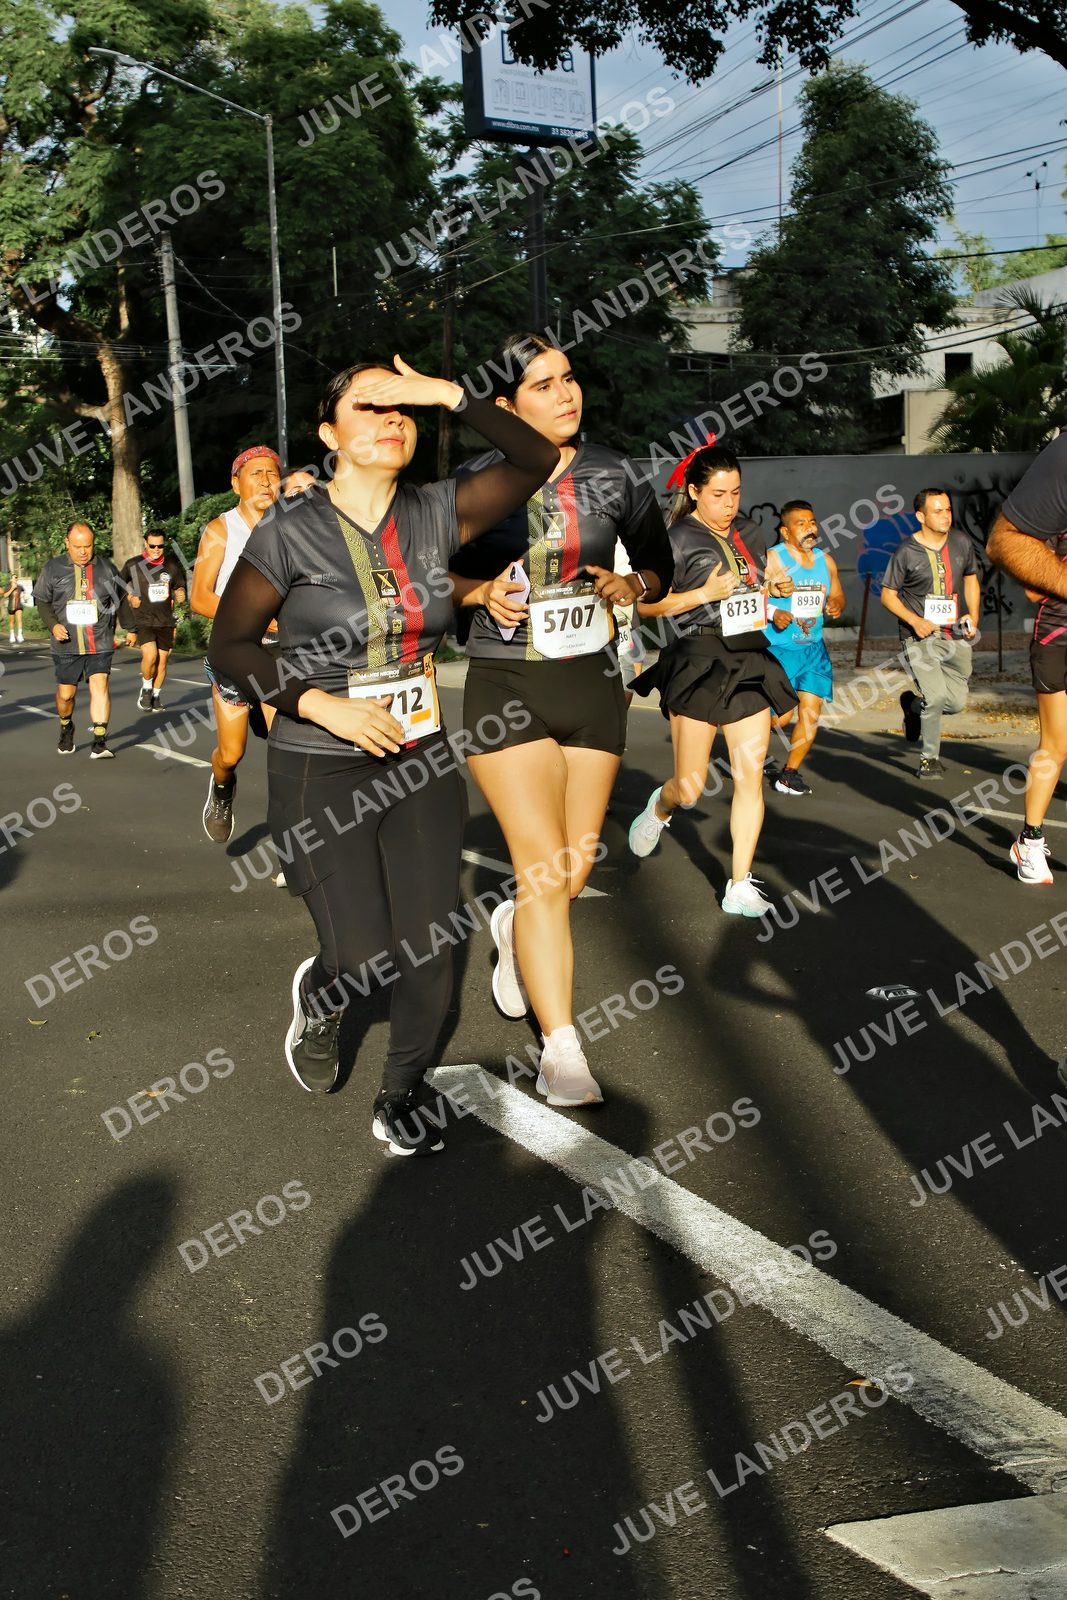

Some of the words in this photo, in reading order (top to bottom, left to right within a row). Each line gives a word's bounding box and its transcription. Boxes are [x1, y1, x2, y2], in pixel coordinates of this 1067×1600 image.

[726, 598, 758, 618] 8733
[797, 595, 821, 606] 8930
[544, 604, 596, 634] 5707
[619, 630, 629, 643] 36
[366, 686, 423, 715] 712
